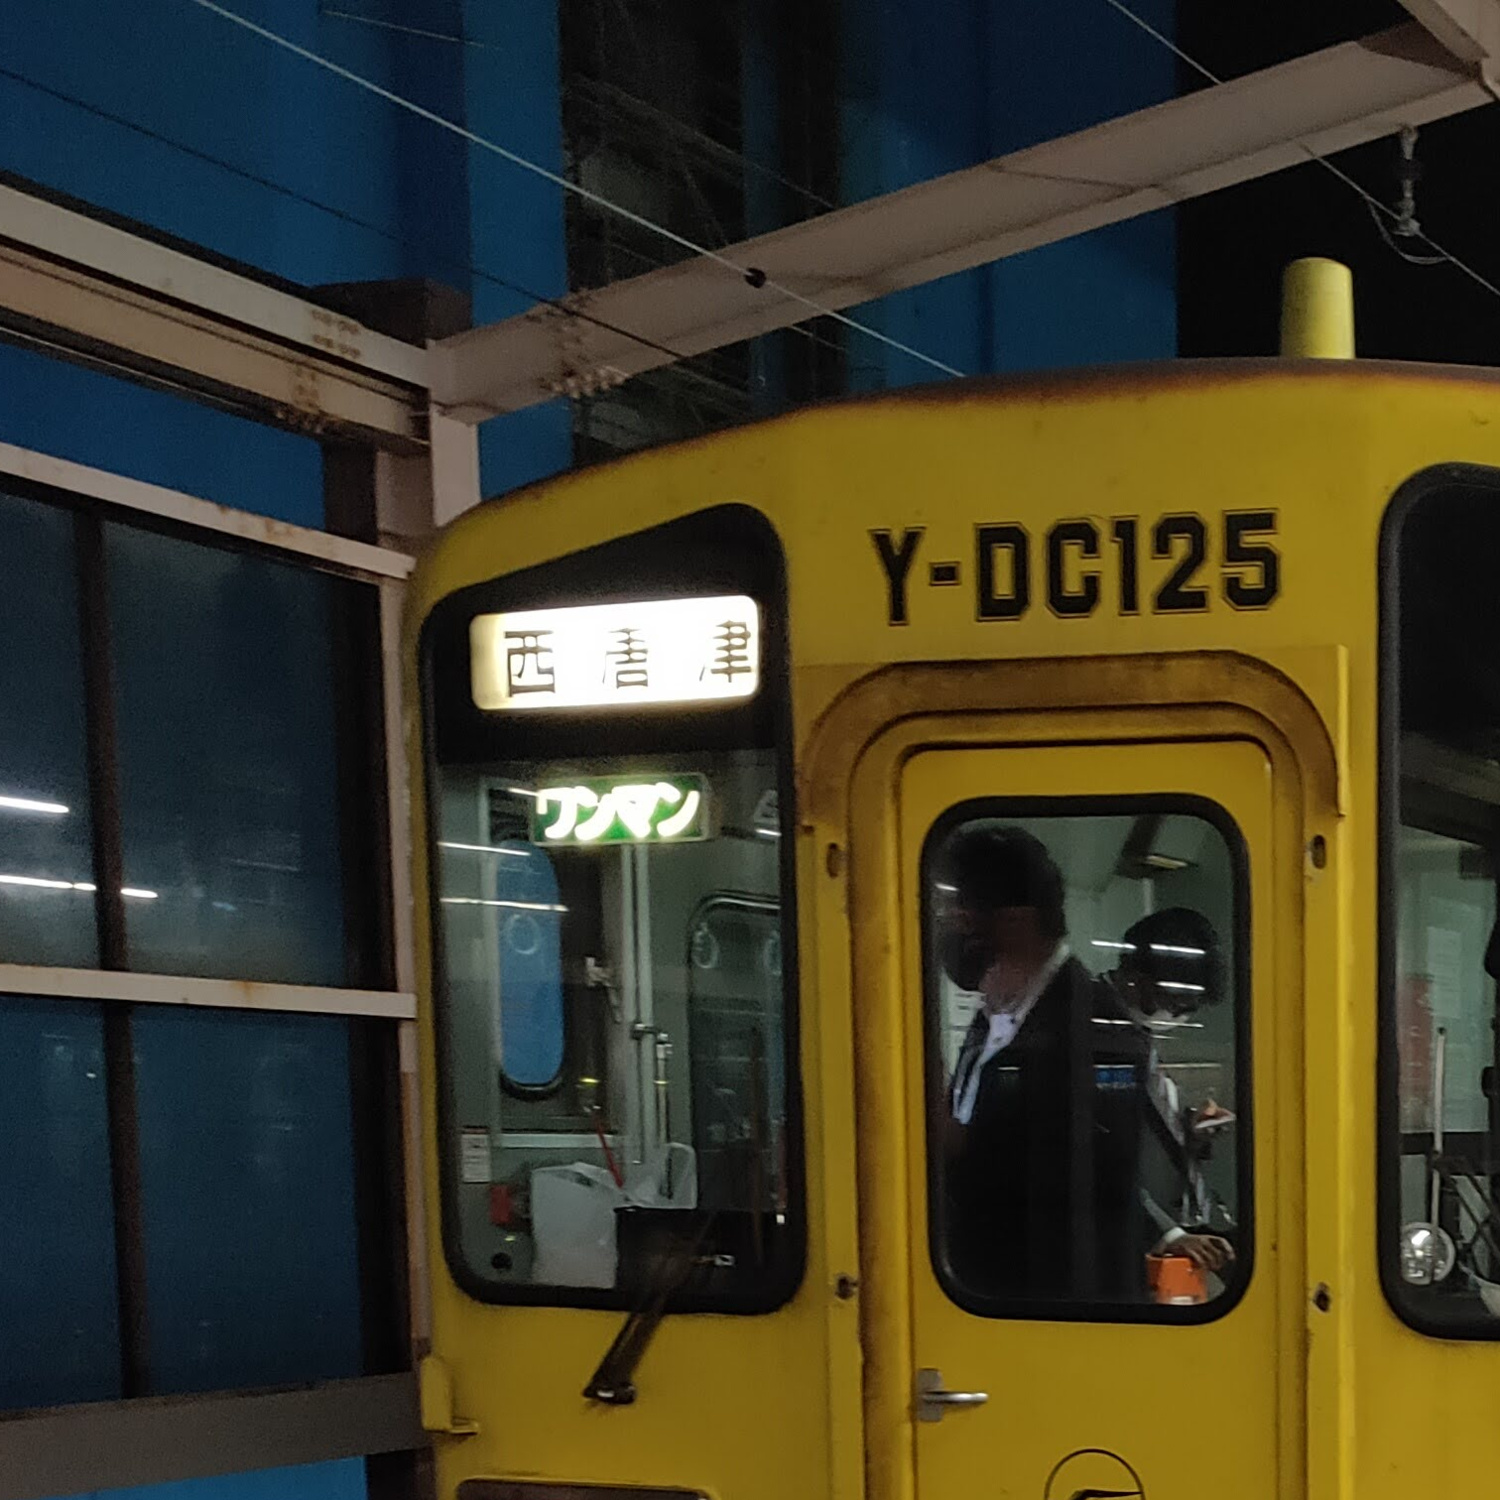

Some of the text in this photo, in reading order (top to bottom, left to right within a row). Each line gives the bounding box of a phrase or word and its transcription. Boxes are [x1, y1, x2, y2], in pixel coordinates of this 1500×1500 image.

[869, 510, 1281, 626] Y-DC125
[504, 620, 752, 698] 西唐津
[536, 782, 700, 841] ワンマン
